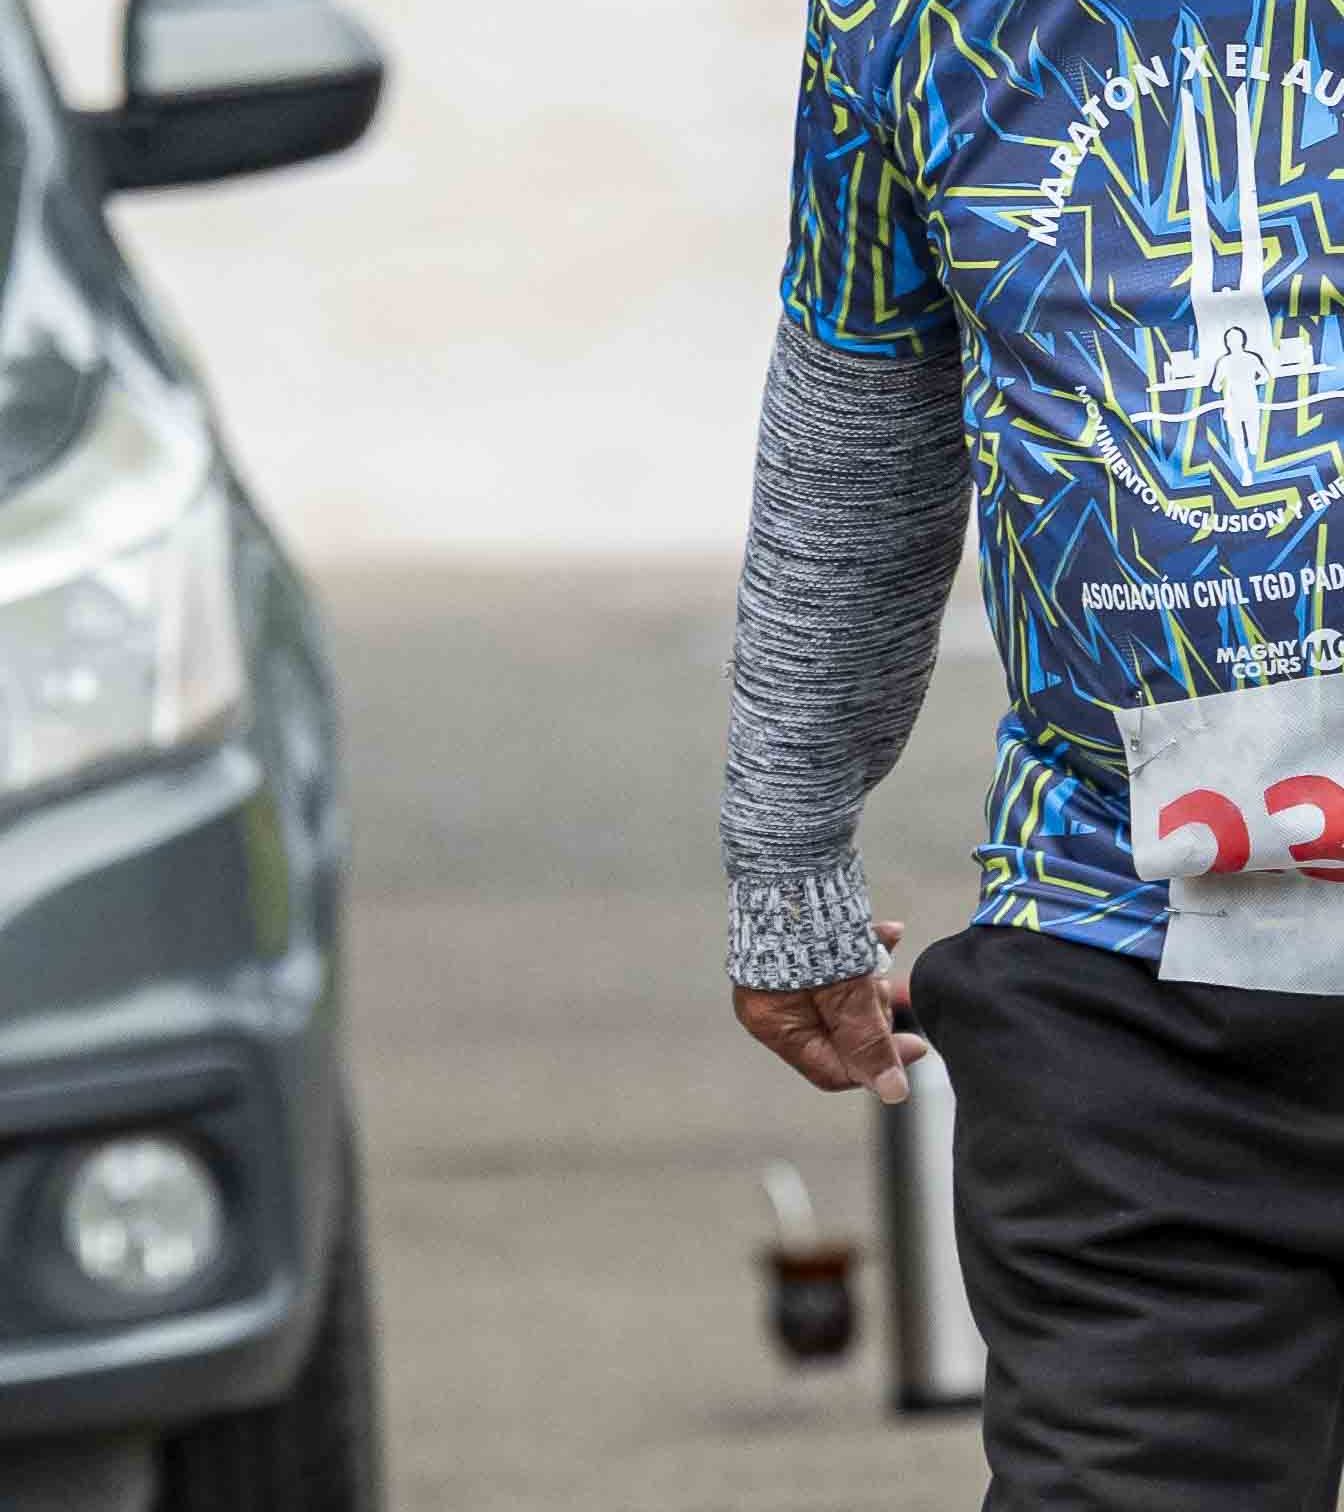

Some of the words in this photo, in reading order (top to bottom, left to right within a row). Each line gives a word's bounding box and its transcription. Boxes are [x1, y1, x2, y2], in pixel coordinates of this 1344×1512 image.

[1027, 55, 1170, 247] MARATÓN
[1179, 44, 1213, 80] X
[1225, 43, 1270, 82] EL
[1164, 500, 1285, 532] INCLUSIÓN
[1081, 574, 1191, 611] ASOCIACIÓN
[1193, 581, 1250, 608] CIVIL
[1250, 571, 1296, 602] TGD
[1216, 639, 1299, 664] MAGNY
[1231, 656, 1302, 680] COURS
